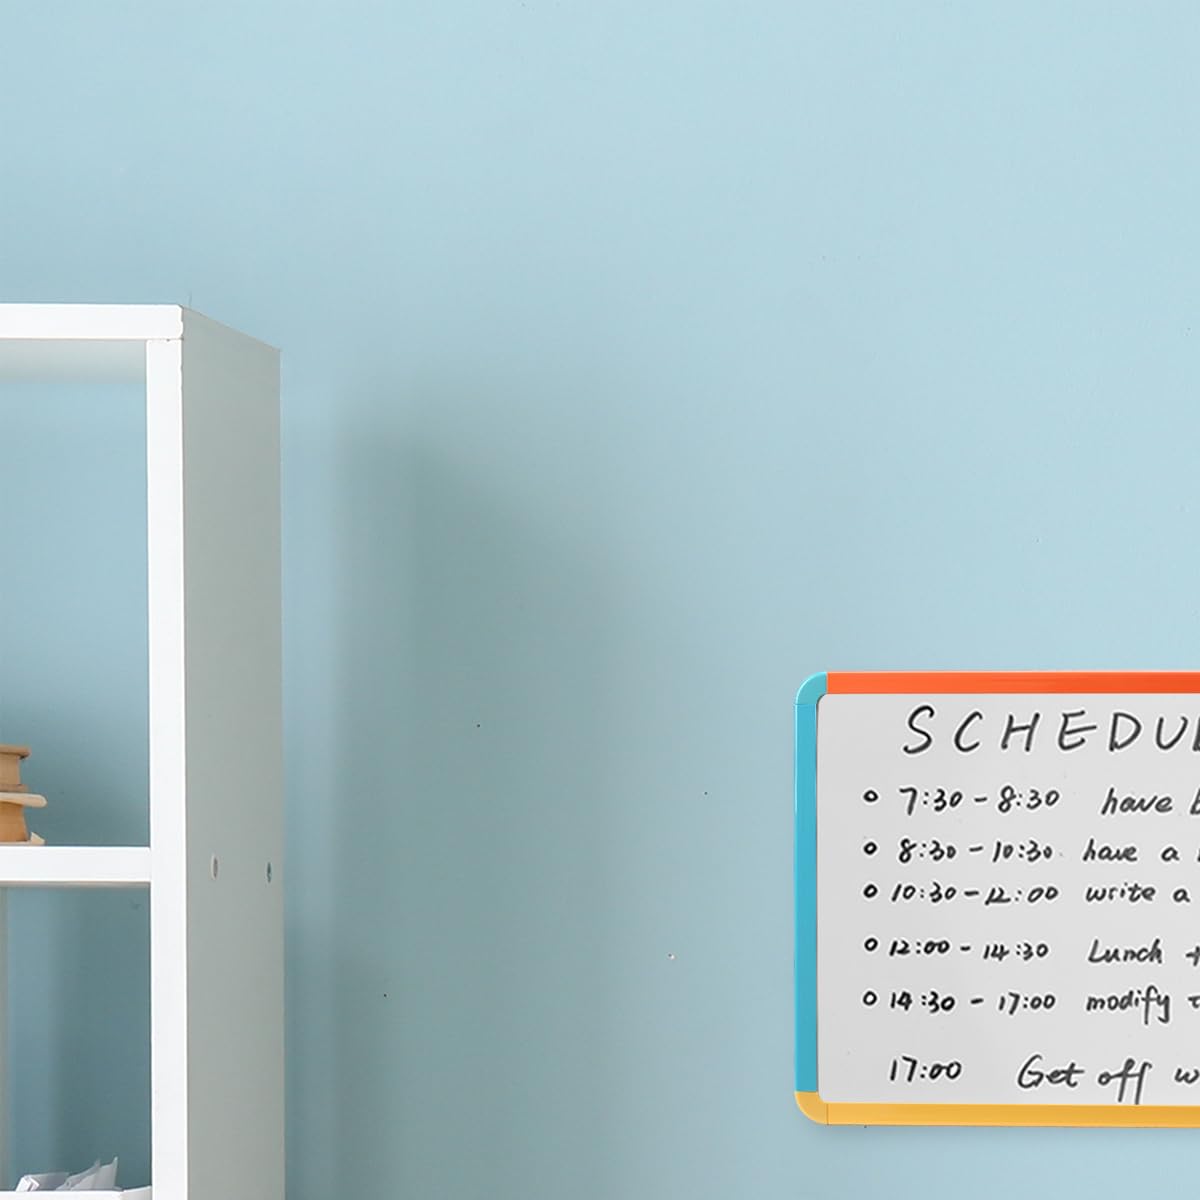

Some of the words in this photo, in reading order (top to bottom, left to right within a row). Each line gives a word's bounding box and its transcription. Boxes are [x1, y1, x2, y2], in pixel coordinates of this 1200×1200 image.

[898, 787, 963, 817] 7:30
[997, 785, 1060, 814] 8:30
[1100, 787, 1173, 816] have
[898, 837, 957, 864] 8:30
[992, 839, 1053, 863] 10:30
[1082, 838, 1138, 863] have
[1160, 846, 1180, 862] a
[1085, 881, 1156, 903] write
[1172, 888, 1191, 903] a
[888, 939, 951, 957] 12:00
[982, 943, 1049, 962] 14:30
[1087, 938, 1163, 965] Lunch
[889, 990, 956, 1014] 14:30
[998, 991, 1056, 1016] 17:00
[1086, 984, 1171, 1026] modify
[889, 1055, 963, 1083] 17:00
[1017, 1054, 1085, 1089] Get
[1097, 1057, 1154, 1105] off
